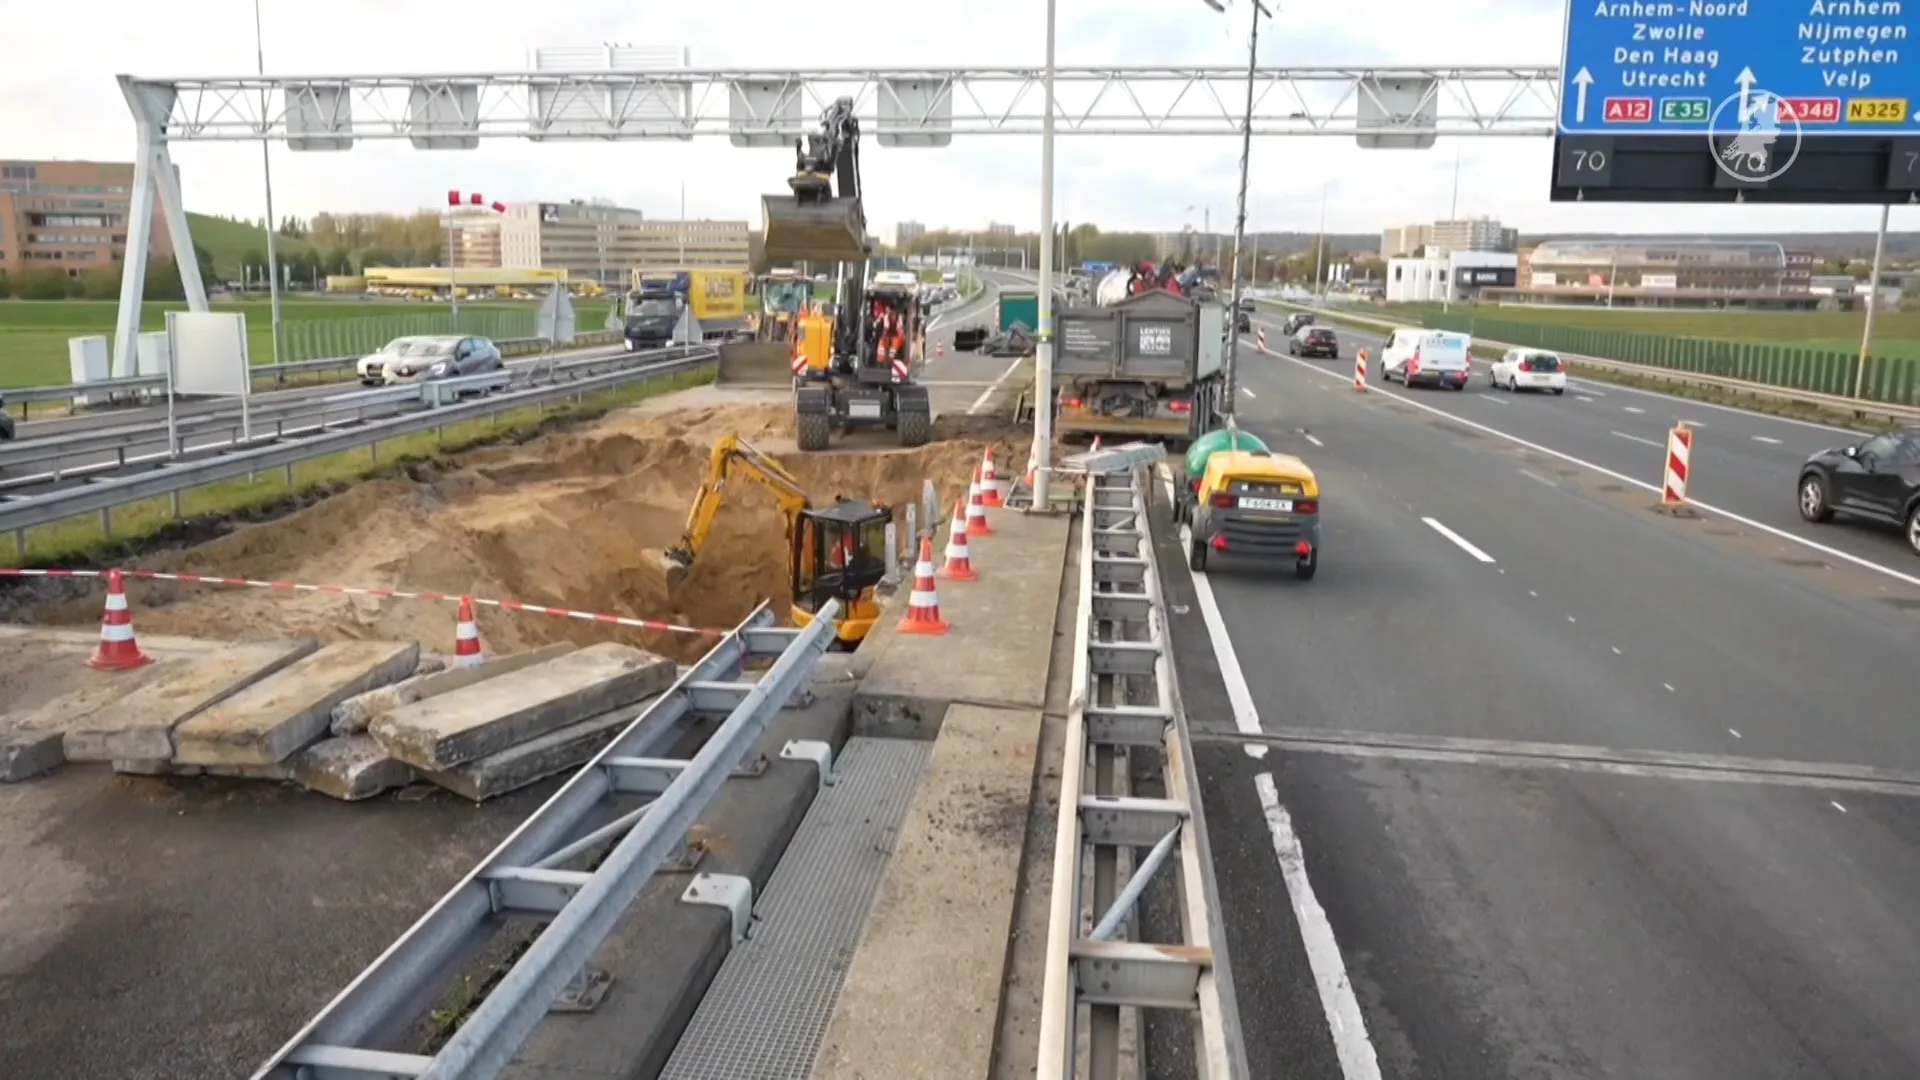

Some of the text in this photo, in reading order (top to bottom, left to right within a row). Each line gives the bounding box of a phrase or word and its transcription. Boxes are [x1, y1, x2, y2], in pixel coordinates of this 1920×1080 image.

[1809, 0, 1901, 16] Arnhem
[1632, 23, 1705, 41] Zwolle
[1798, 22, 1907, 45] Nijmegen
[1614, 47, 1719, 68] Den Haag
[1801, 46, 1899, 66] Zutphen
[1622, 69, 1707, 87] Utrecht
[1822, 69, 1872, 90] Velp
[1572, 150, 1606, 171] 70
